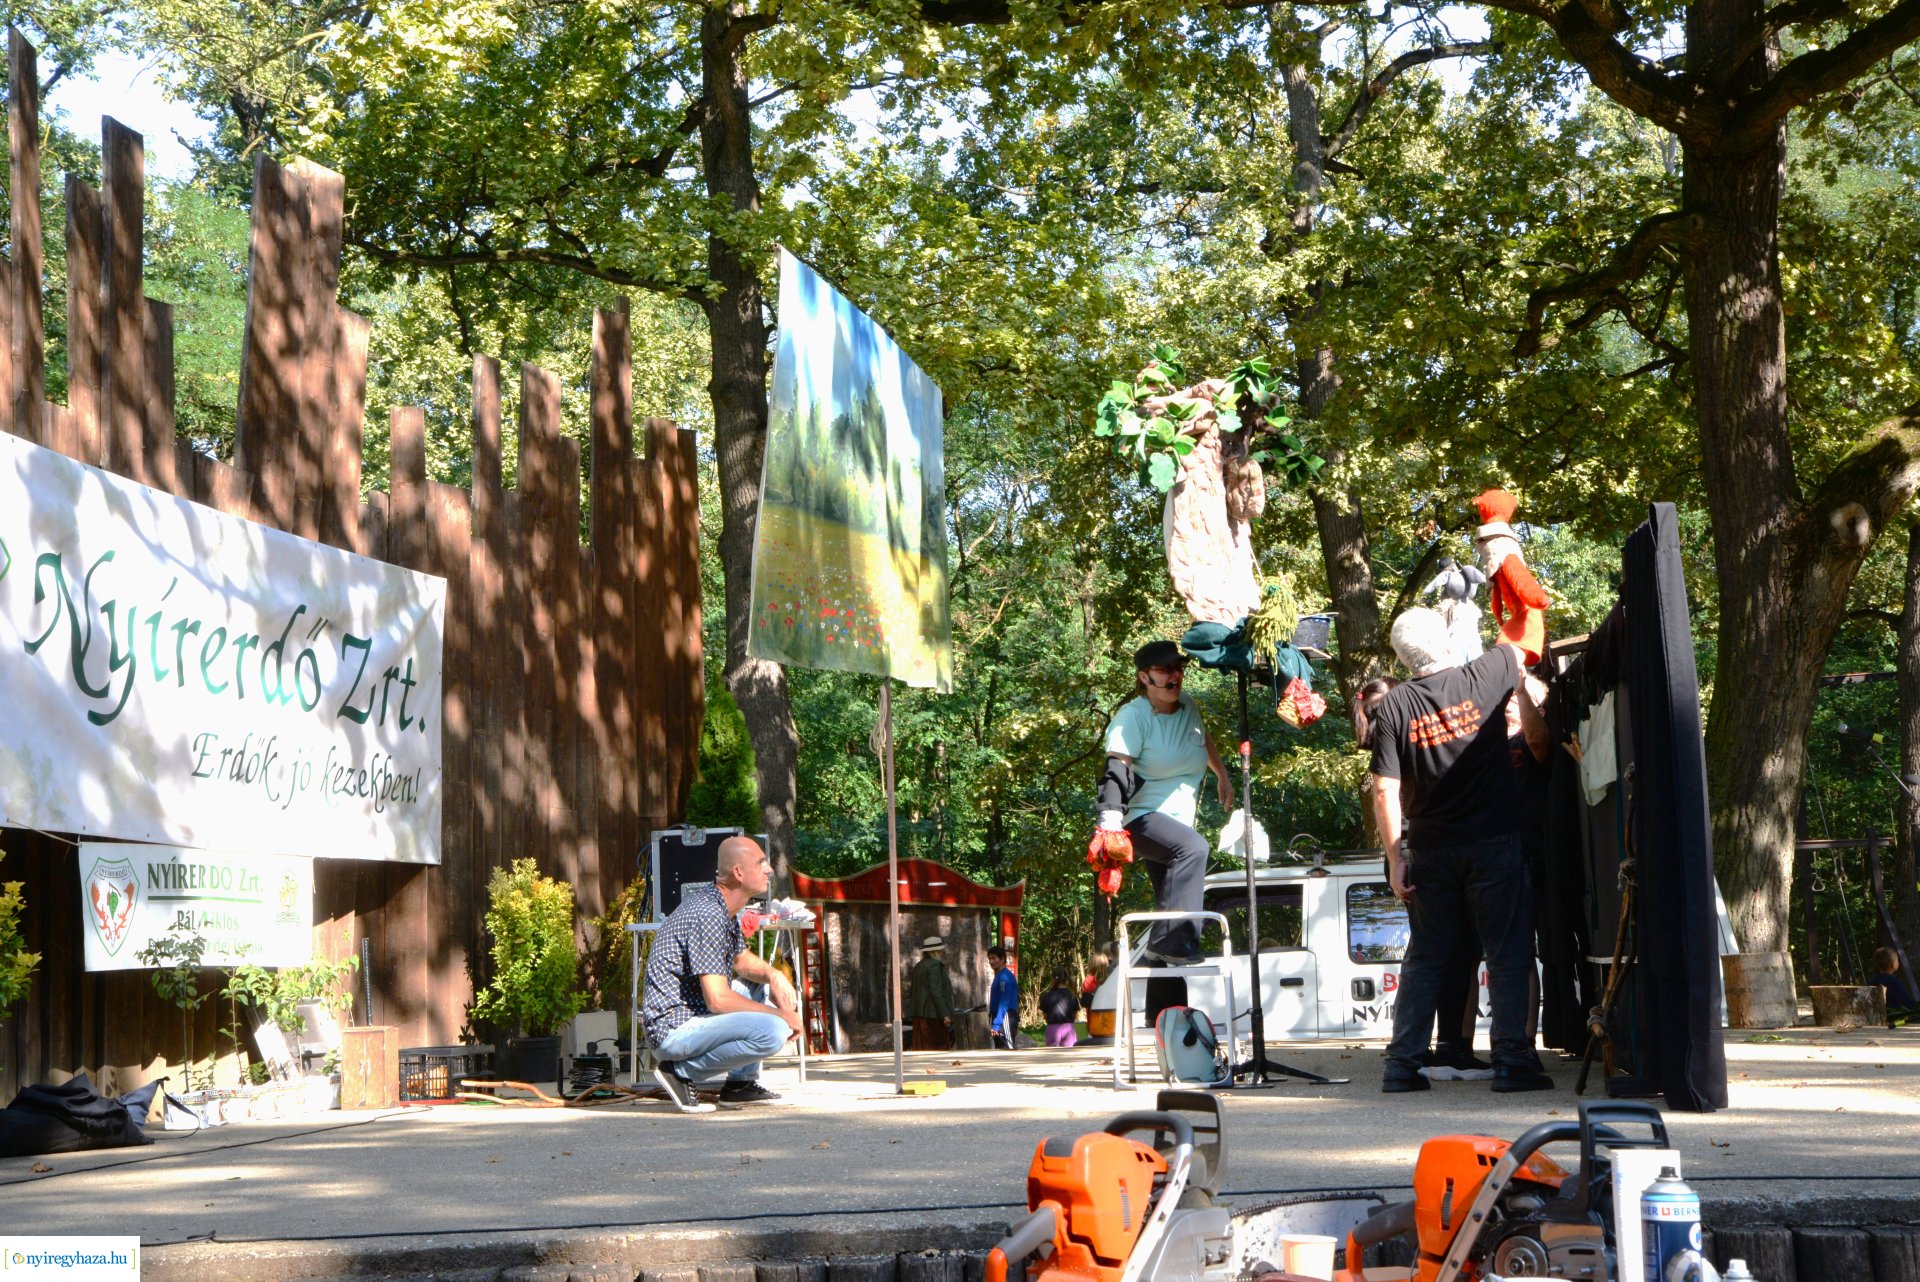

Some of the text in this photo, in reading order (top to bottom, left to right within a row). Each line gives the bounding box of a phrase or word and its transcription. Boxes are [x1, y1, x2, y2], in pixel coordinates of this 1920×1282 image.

[24, 550, 426, 735] Nyírerdő Zrt.
[191, 732, 422, 814] Erdők jó kezekben!
[147, 856, 264, 893] NYÍRERDŐ Zrt.
